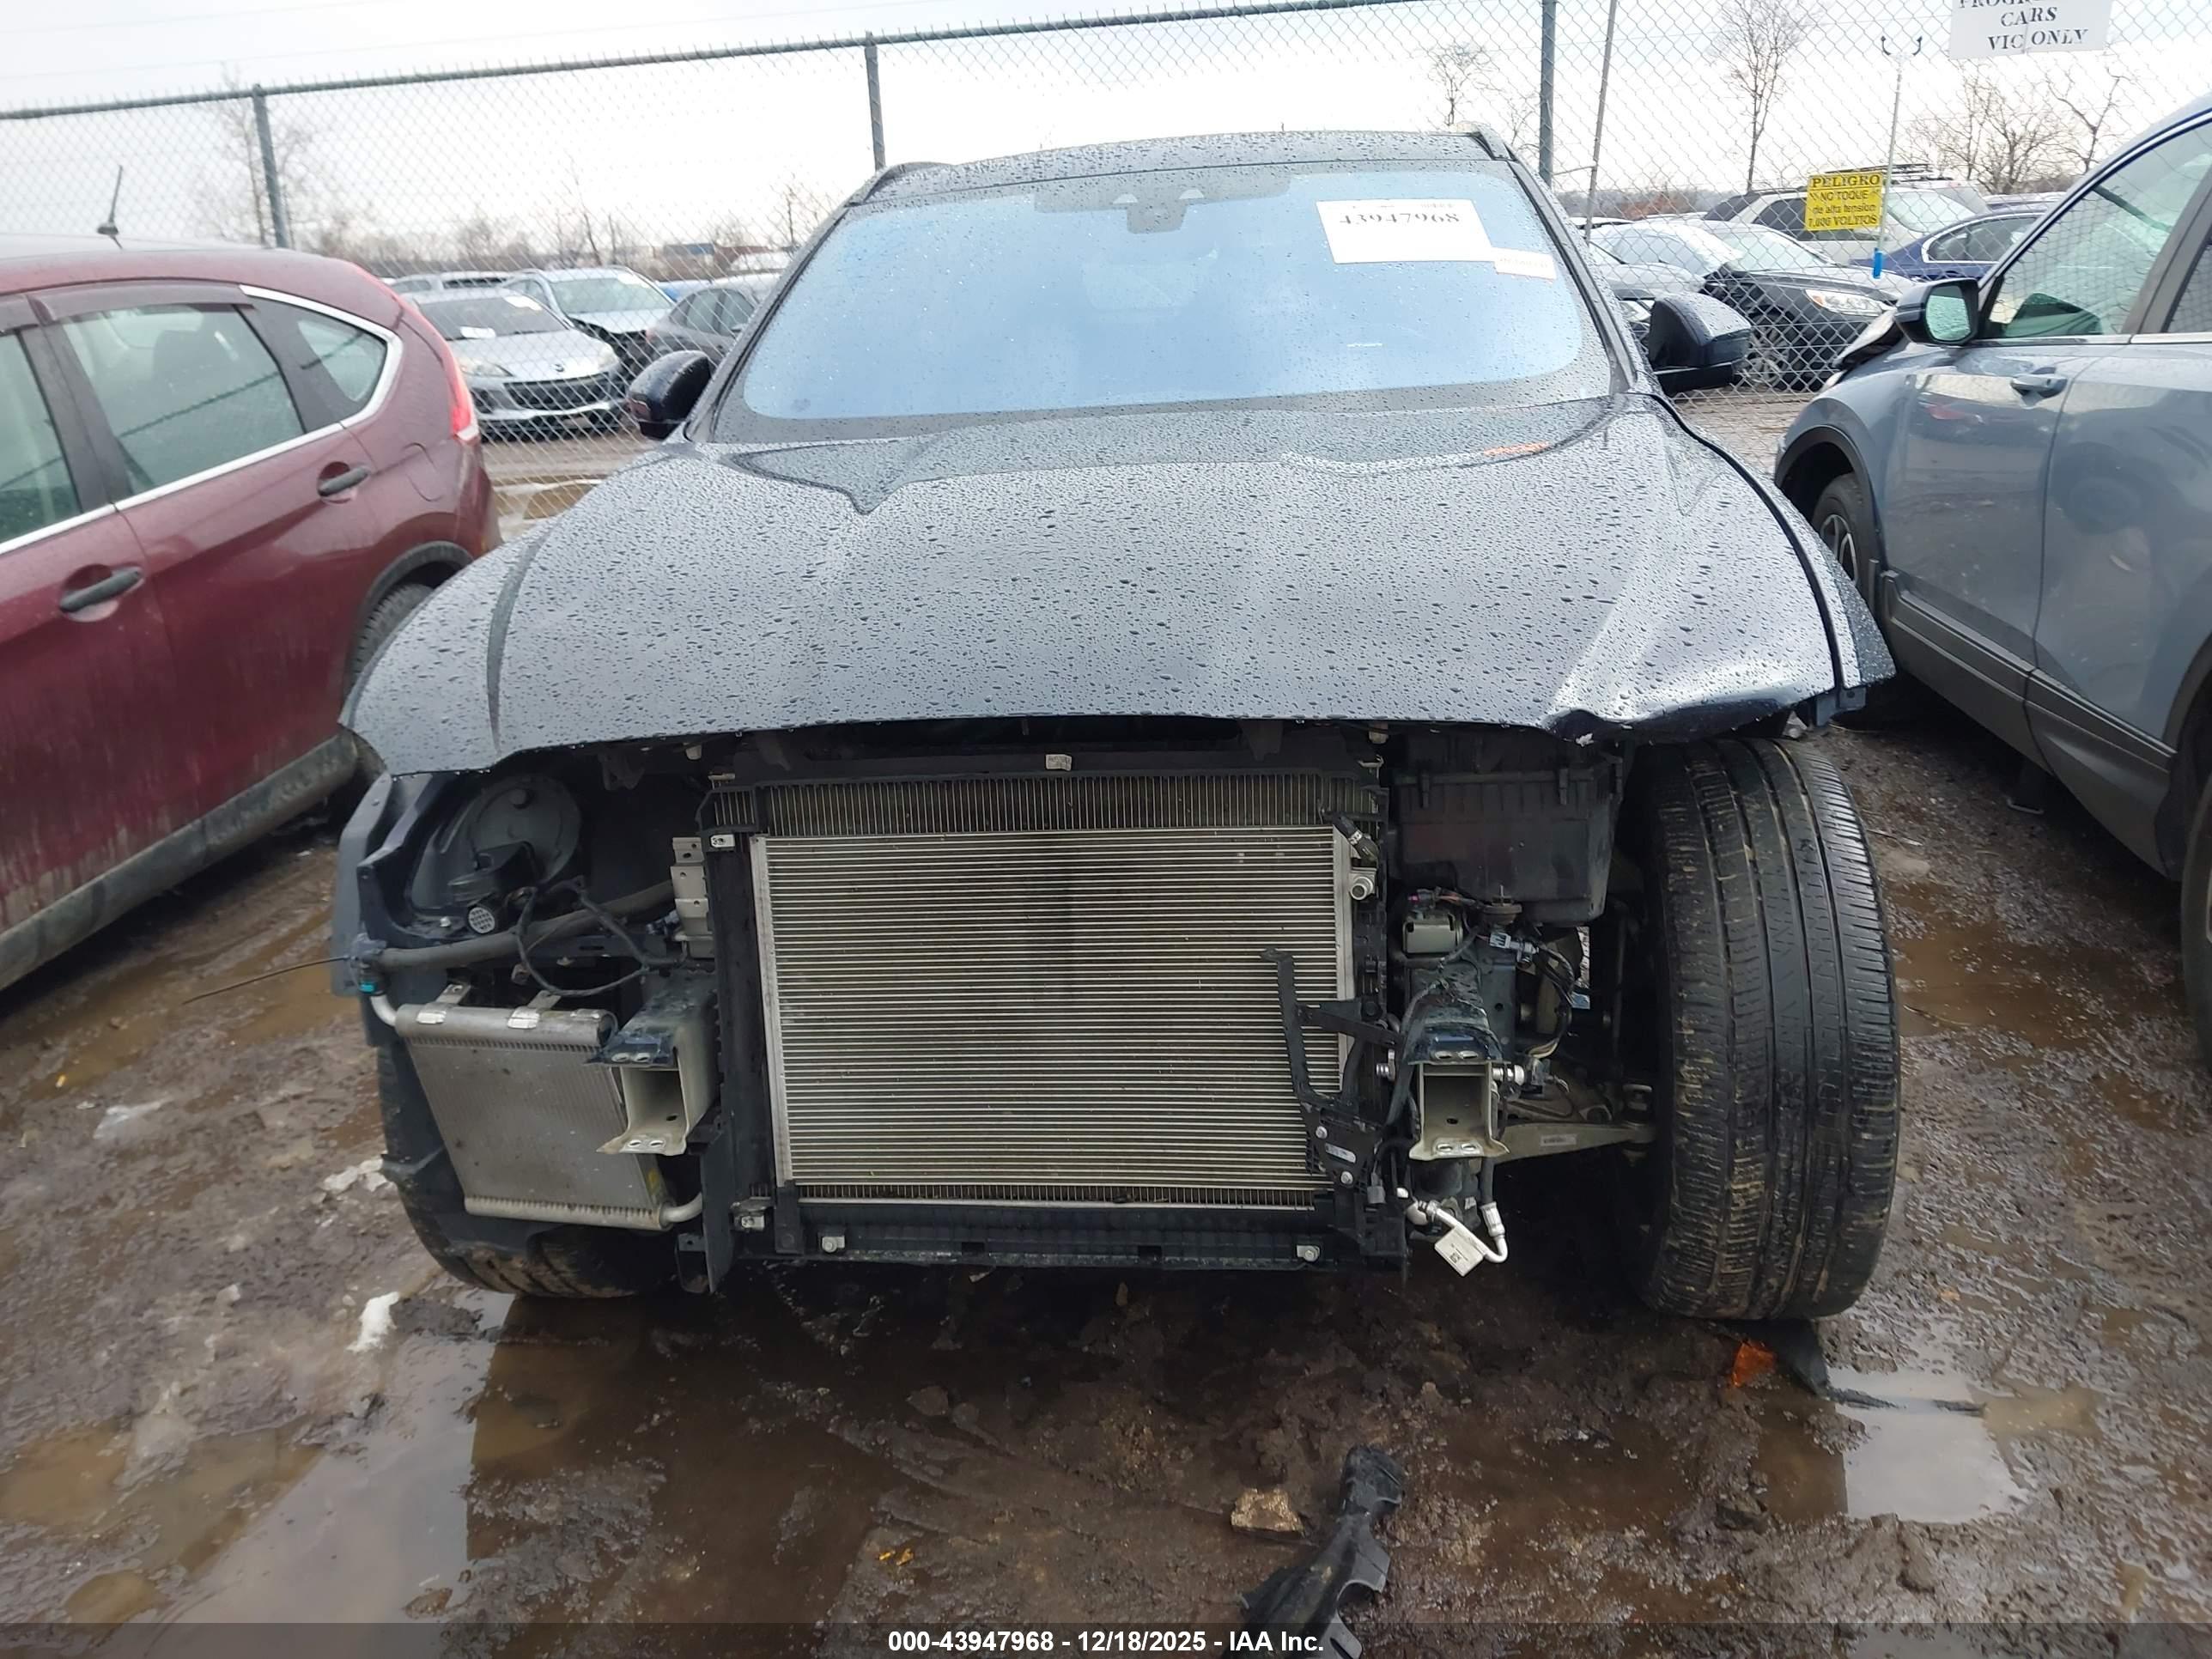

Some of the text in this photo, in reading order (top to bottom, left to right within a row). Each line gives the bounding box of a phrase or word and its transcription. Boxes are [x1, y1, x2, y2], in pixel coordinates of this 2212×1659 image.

[2000, 7, 2057, 27] CARS
[2031, 29, 2088, 46] ONLY
[1813, 174, 1880, 188] PELIGRO
[1820, 190, 1869, 201] NO TOQUE
